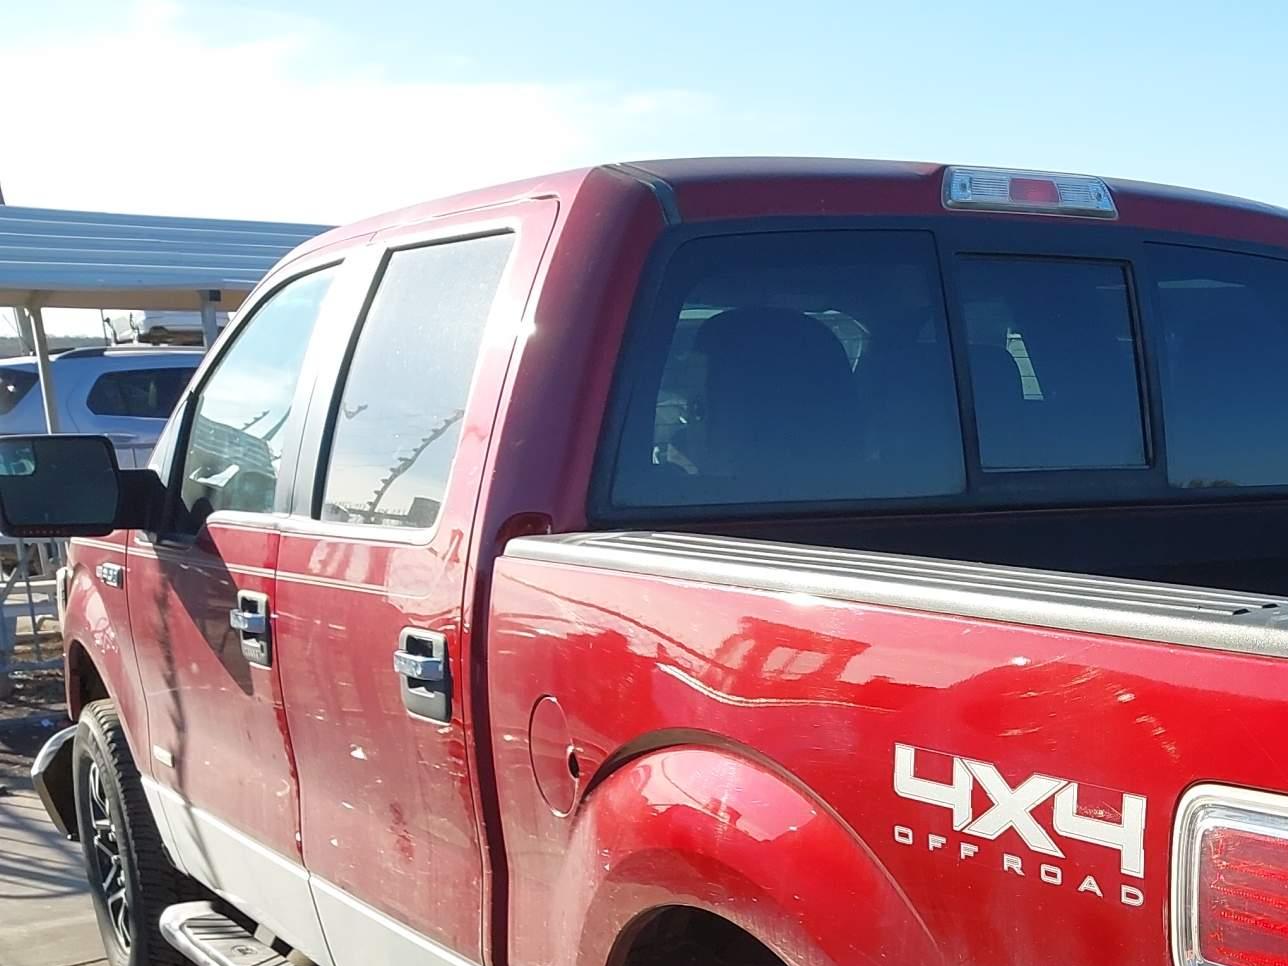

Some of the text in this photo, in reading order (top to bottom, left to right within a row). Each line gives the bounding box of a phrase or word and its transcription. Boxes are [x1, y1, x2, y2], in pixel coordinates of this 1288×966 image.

[893, 742, 1147, 878] 4X4
[893, 825, 1145, 908] OFF ROAD
